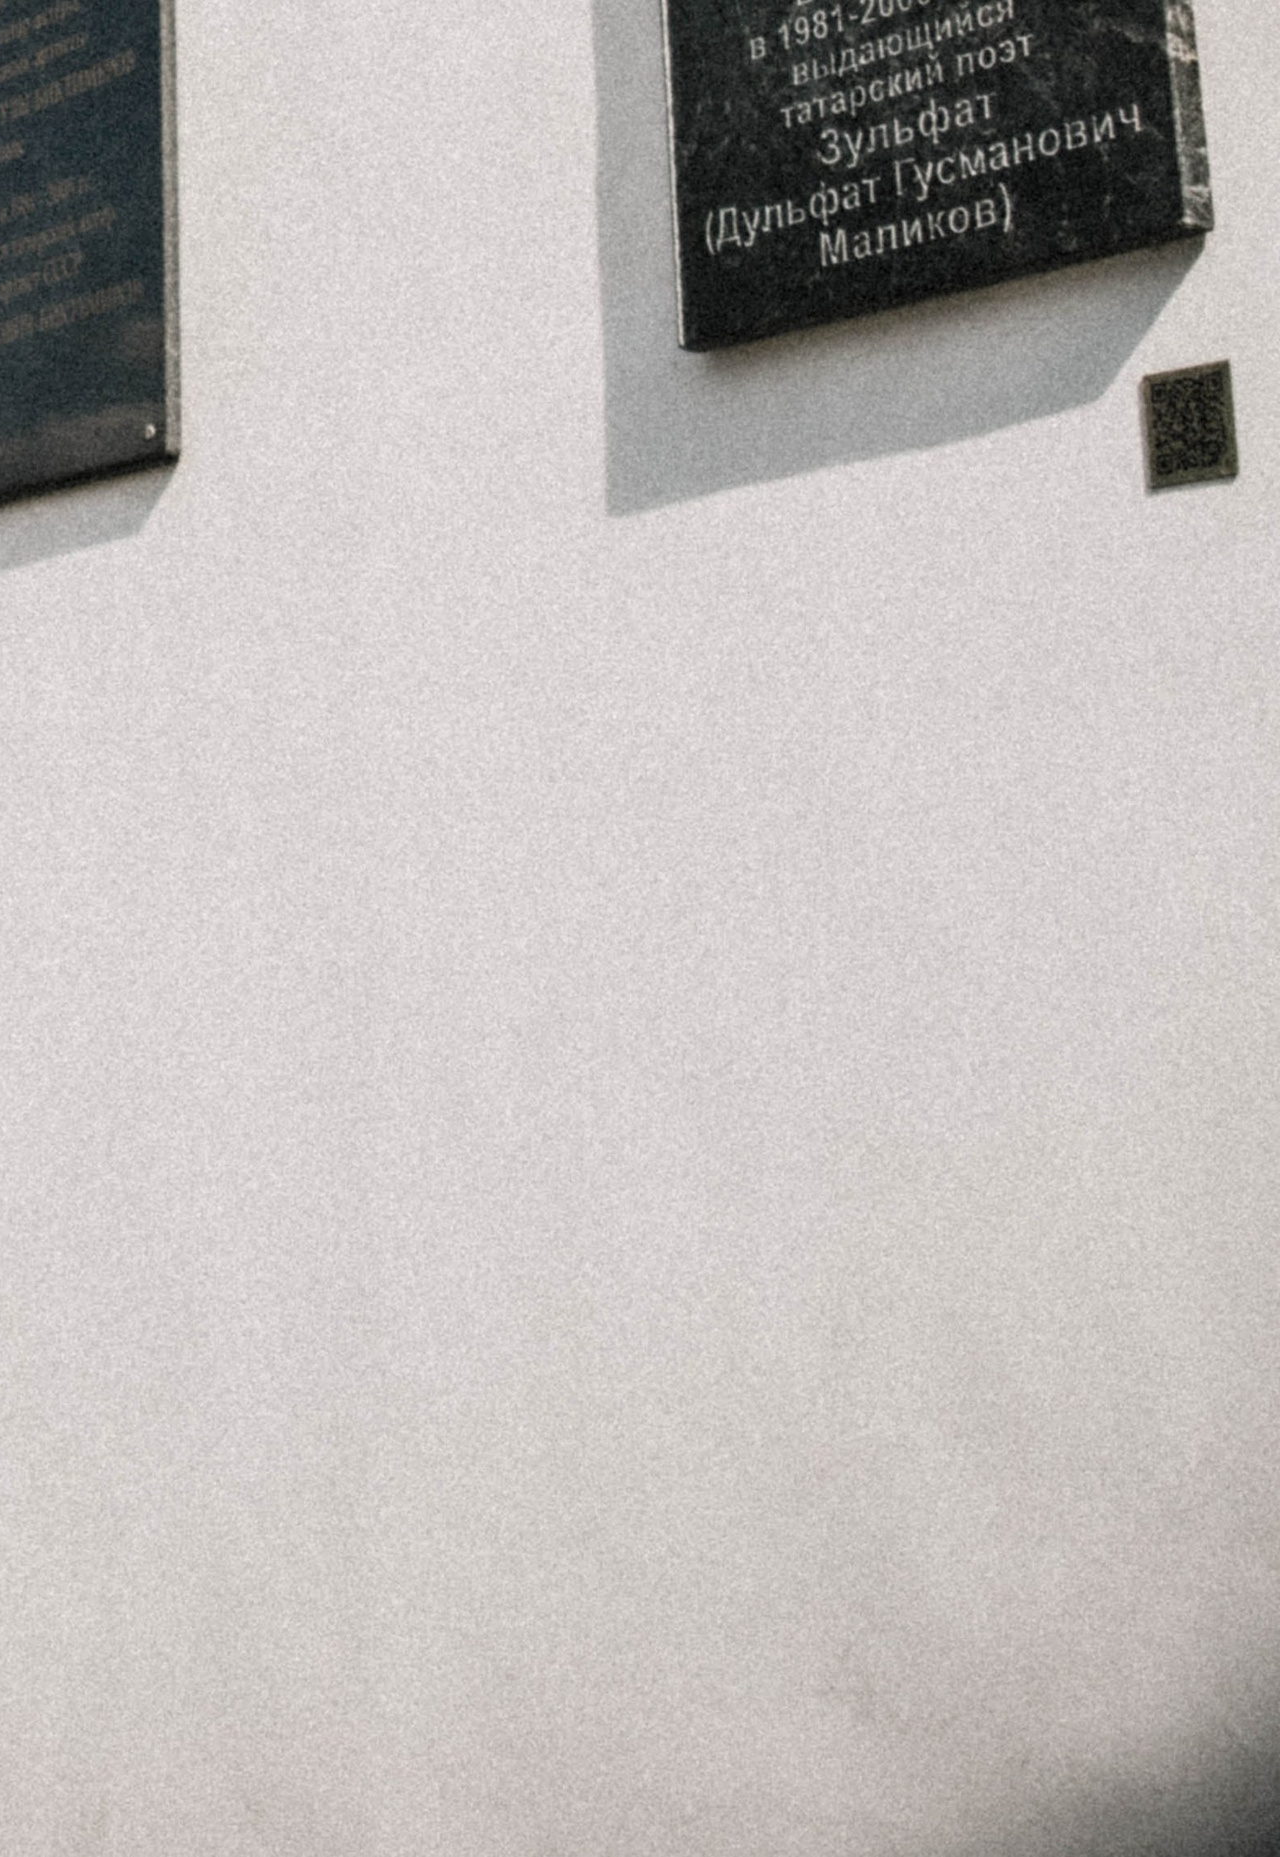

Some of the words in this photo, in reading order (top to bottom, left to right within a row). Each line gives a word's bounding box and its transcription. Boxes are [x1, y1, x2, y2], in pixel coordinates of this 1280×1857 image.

[750, 35, 767, 61] в
[779, 47, 945, 129] татарский
[956, 32, 1035, 76] поэт
[818, 92, 997, 169] Зульфат
[704, 176, 881, 256] (Дульфат
[893, 102, 1143, 202] Гусманович
[819, 181, 1014, 267] Маликов)
